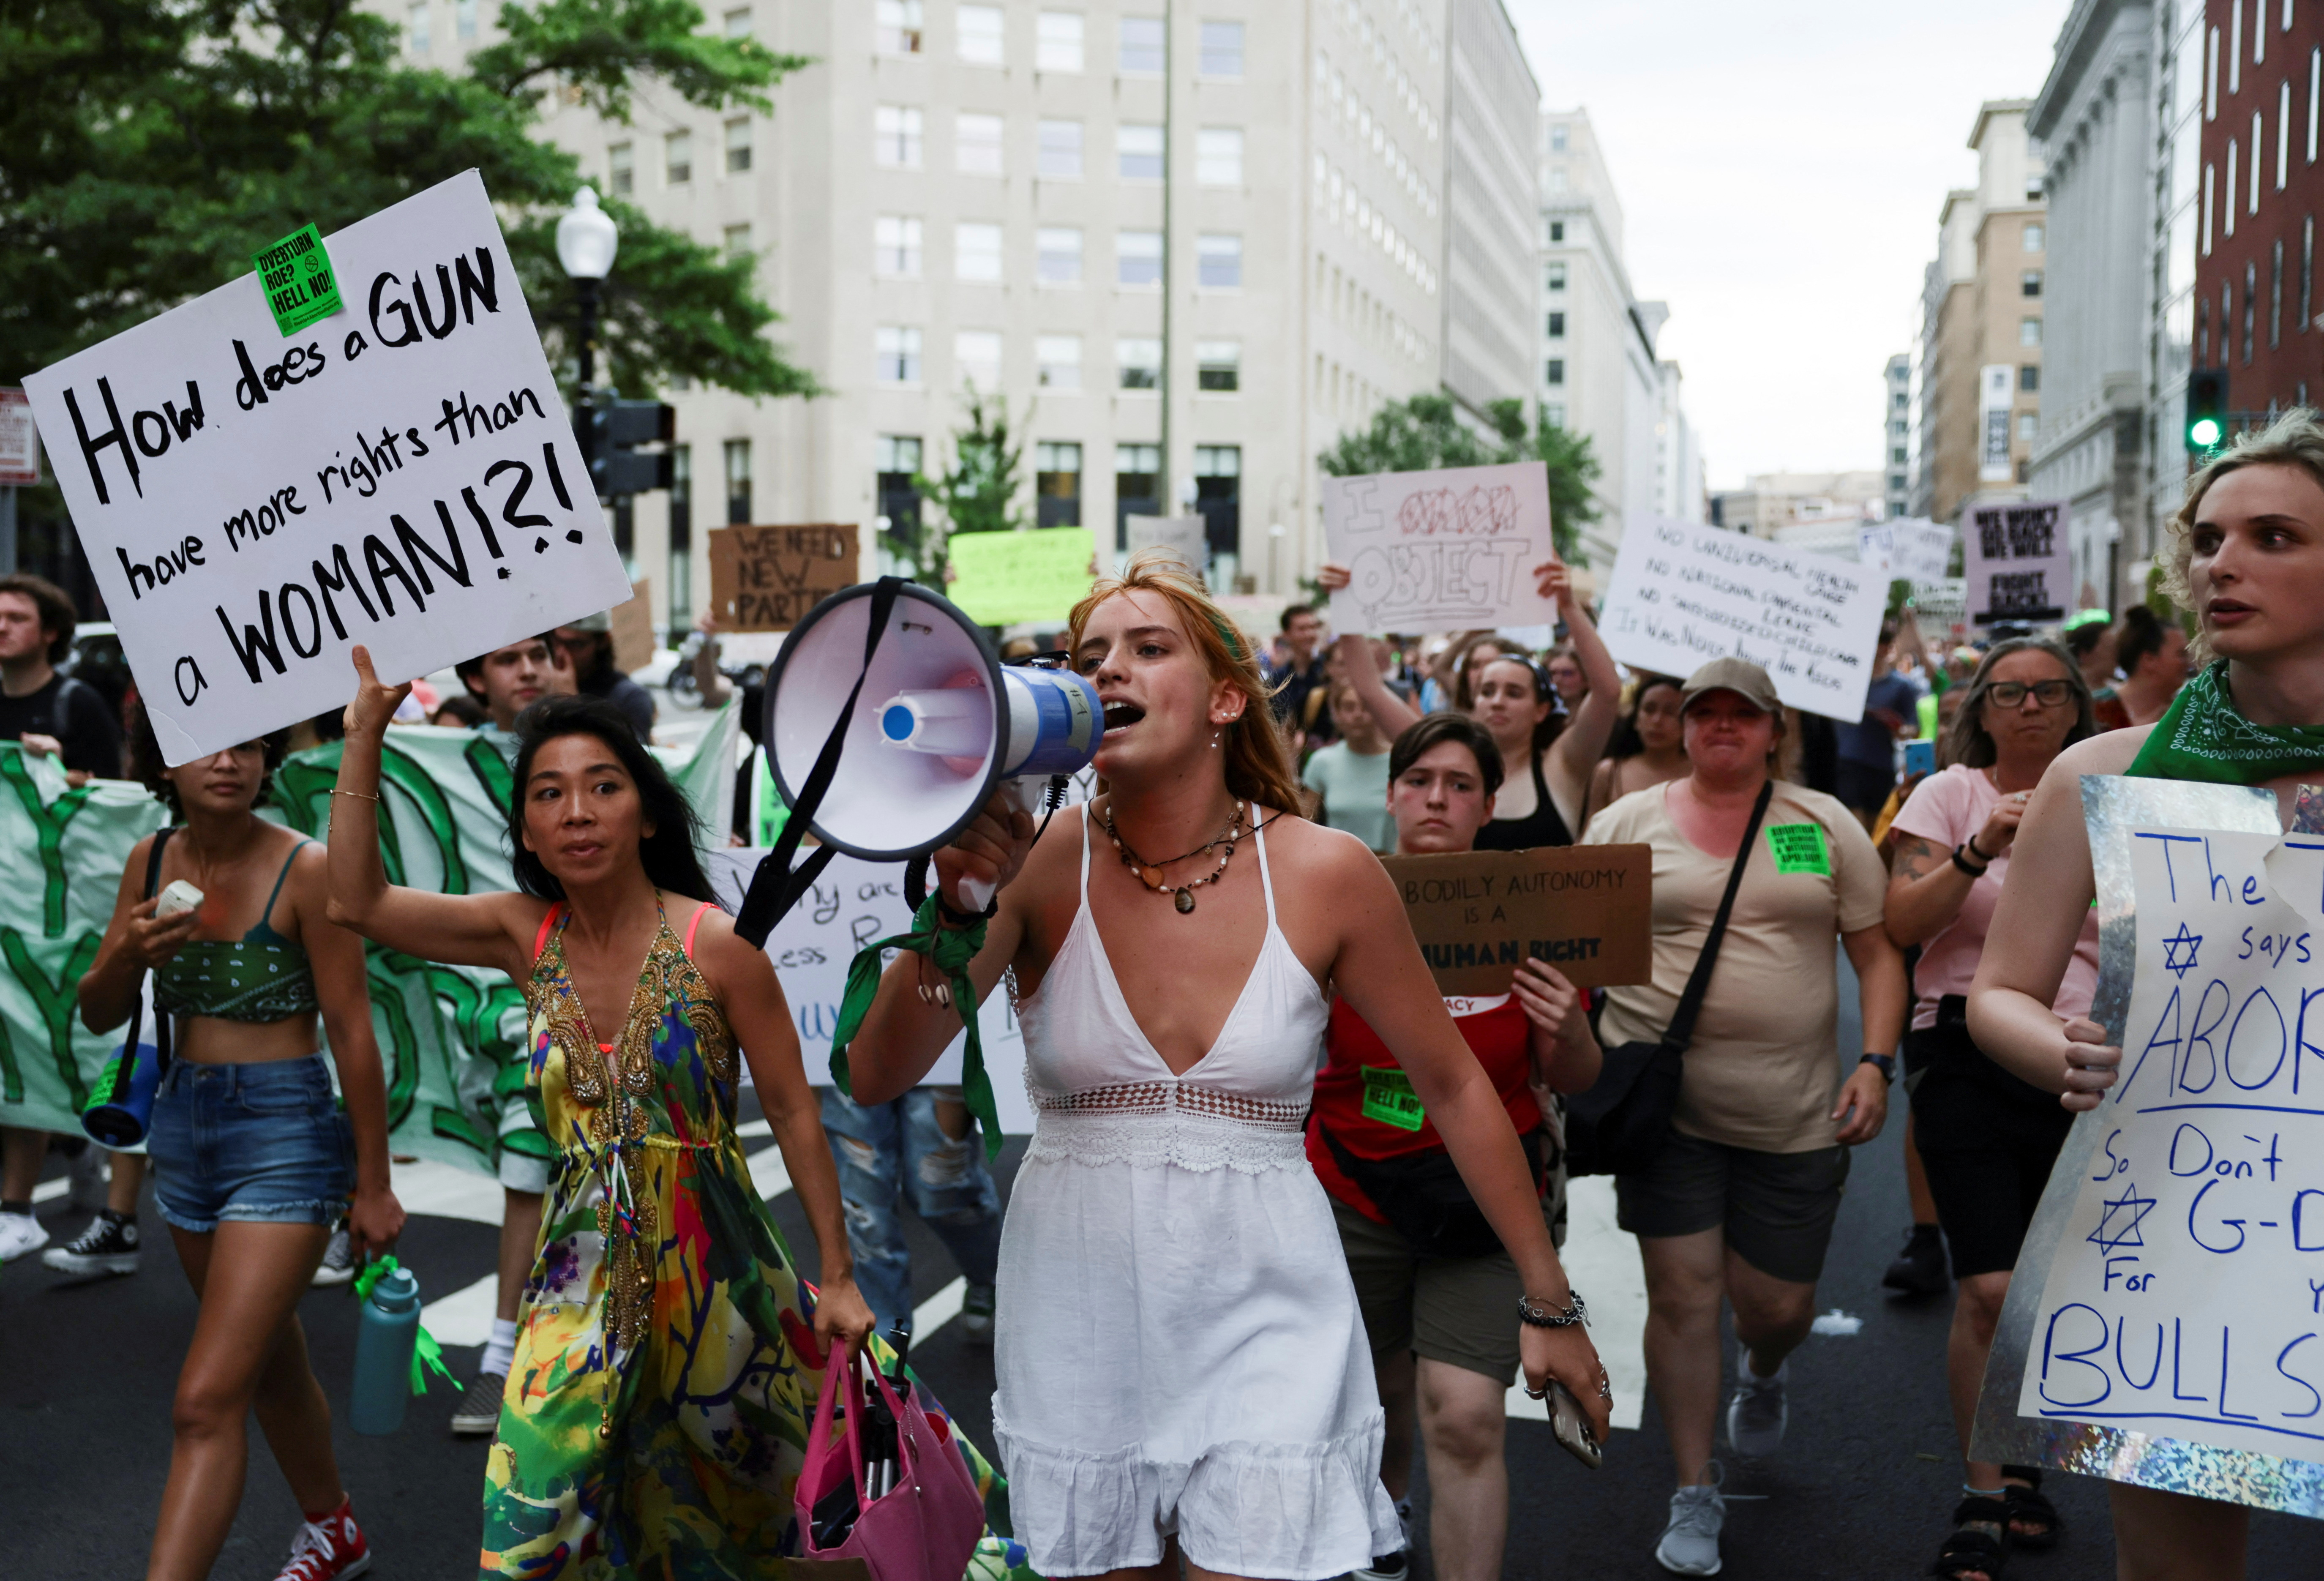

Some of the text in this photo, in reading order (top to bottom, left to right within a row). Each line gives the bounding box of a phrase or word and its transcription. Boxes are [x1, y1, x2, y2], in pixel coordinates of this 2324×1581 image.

[259, 232, 315, 273] OVERTURN
[265, 263, 295, 292] ROE?
[272, 284, 310, 315] HELL
[307, 270, 333, 298] NO!
[63, 376, 205, 505] How
[232, 339, 325, 411] does
[344, 331, 368, 361] a
[369, 247, 501, 347] GUN
[116, 388, 546, 600] have more rights than
[1342, 478, 1385, 533] I
[735, 525, 847, 560] WE NEED
[1653, 525, 1685, 548] NO
[1692, 535, 1802, 579] UNIVERSAL
[738, 557, 812, 588] NEW
[1352, 538, 1532, 607] OBJECT
[1645, 557, 1843, 628] NO NATIONAL PARENTAL
[1637, 585, 1661, 605] NO
[1761, 607, 1819, 637] LEAVE
[175, 655, 208, 707] a
[1405, 868, 1628, 904] BODILY AUTONOMY
[2134, 833, 2265, 905] The
[856, 882, 899, 901] are
[1464, 904, 1507, 924] IS A
[1530, 938, 1602, 962] RIGHT
[2093, 1123, 2283, 1182] So Don't
[2104, 1256, 2156, 1292] For
